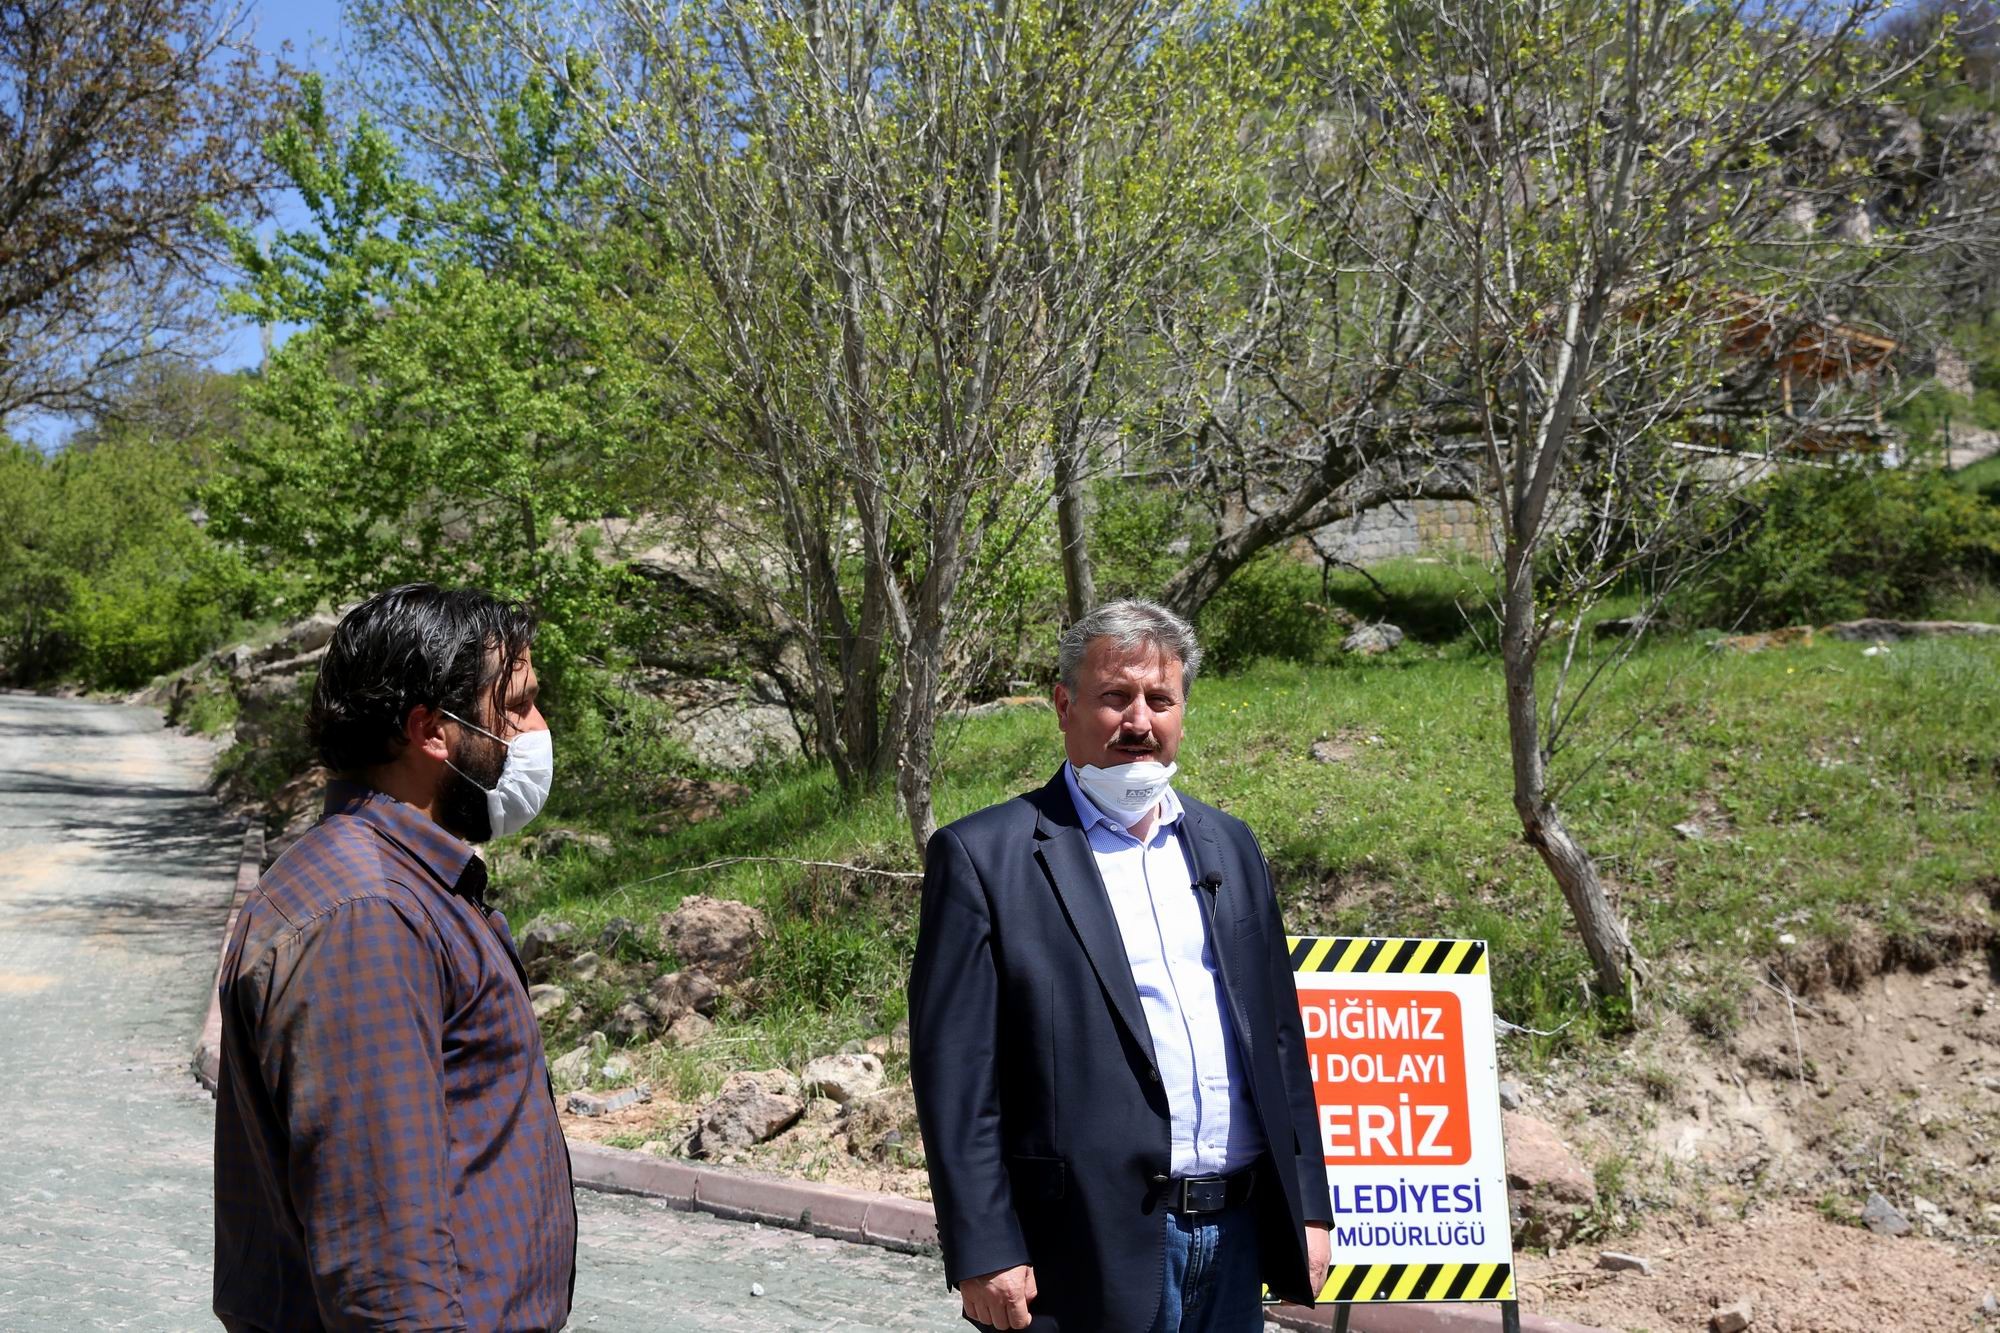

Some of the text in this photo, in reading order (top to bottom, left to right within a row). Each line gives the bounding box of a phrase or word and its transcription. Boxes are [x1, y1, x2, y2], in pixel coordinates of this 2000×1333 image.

[1302, 998, 1444, 1040] DİĞİMİZ
[1327, 1054, 1446, 1083] DOLAYI
[1320, 1092, 1453, 1157] ERİZ
[1329, 1178, 1482, 1213] LEDİYESİ
[1337, 1221, 1486, 1247] MÜDÜRLÜĞÜ
